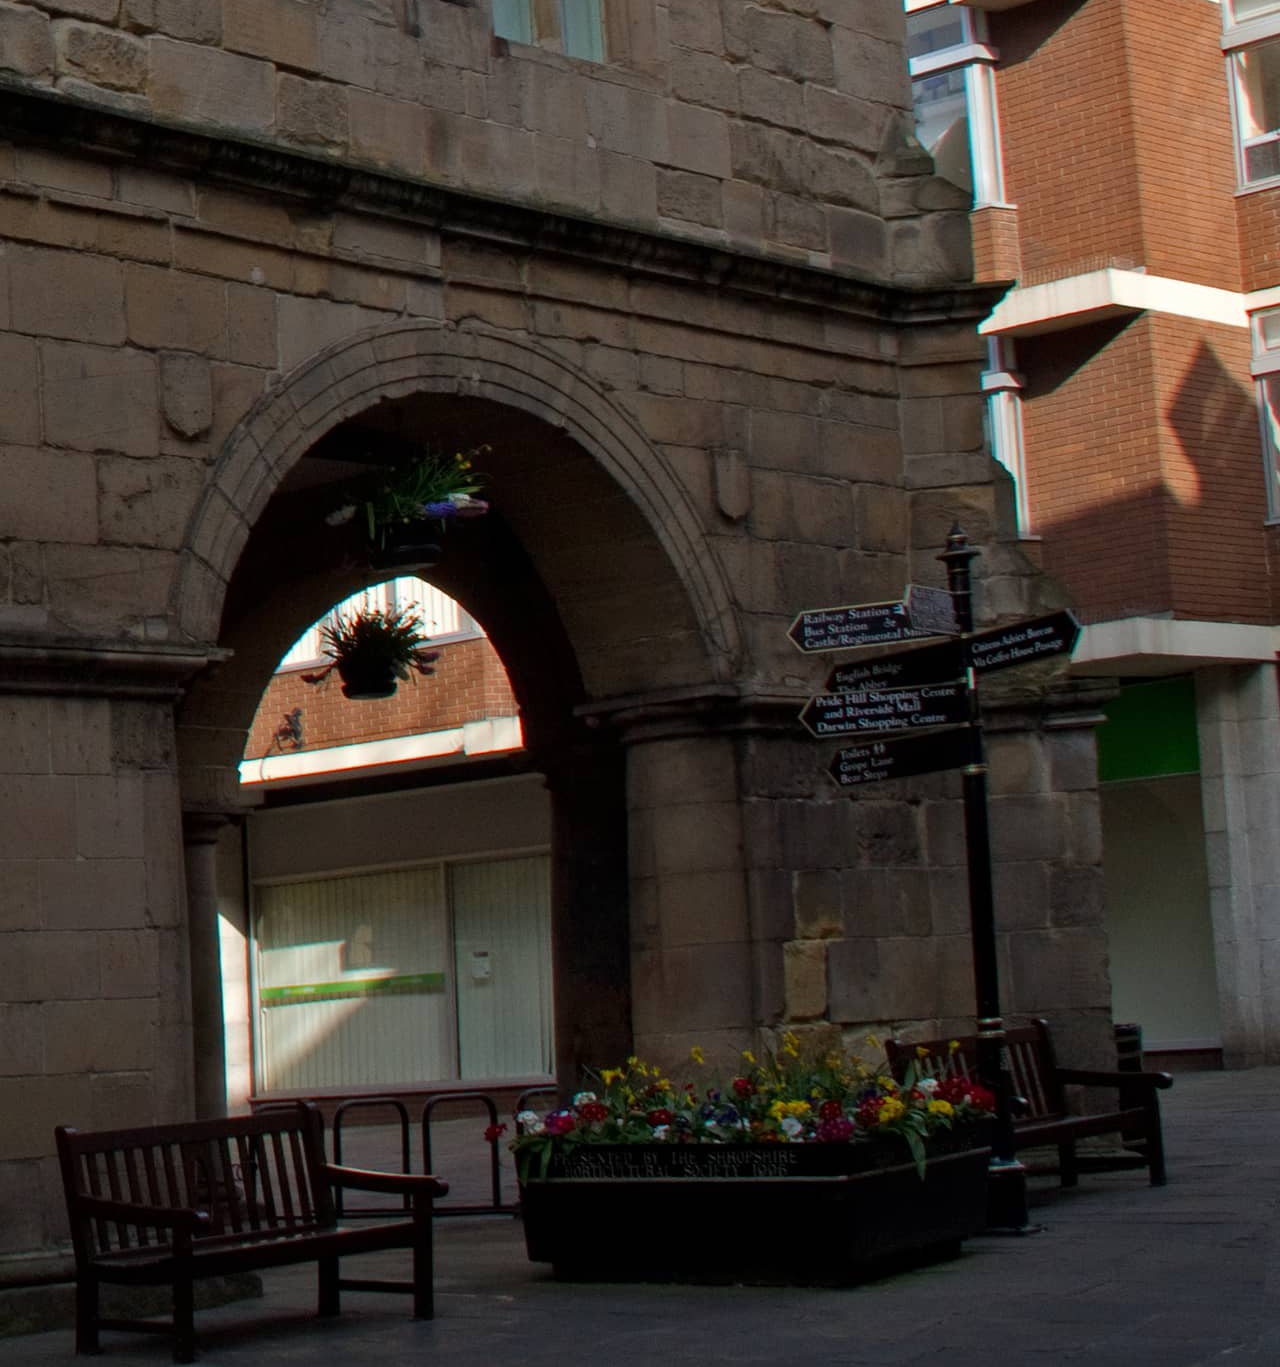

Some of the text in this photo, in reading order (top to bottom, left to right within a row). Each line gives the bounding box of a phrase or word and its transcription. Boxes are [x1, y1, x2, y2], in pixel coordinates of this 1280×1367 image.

[803, 606, 890, 625] Railway Station
[804, 626, 825, 637] Bus
[827, 622, 869, 634] Station
[986, 650, 1011, 665] Coffee
[1011, 646, 1035, 659] House
[835, 662, 904, 683] English Bridge
[815, 687, 957, 707] Pride Hill Shopping Centre
[824, 700, 921, 719] and Riverside Mall
[816, 714, 947, 732] Darwin Shopping Centre
[671, 1151, 697, 1164] THE
[706, 1150, 800, 1164] SHROPSHIRE
